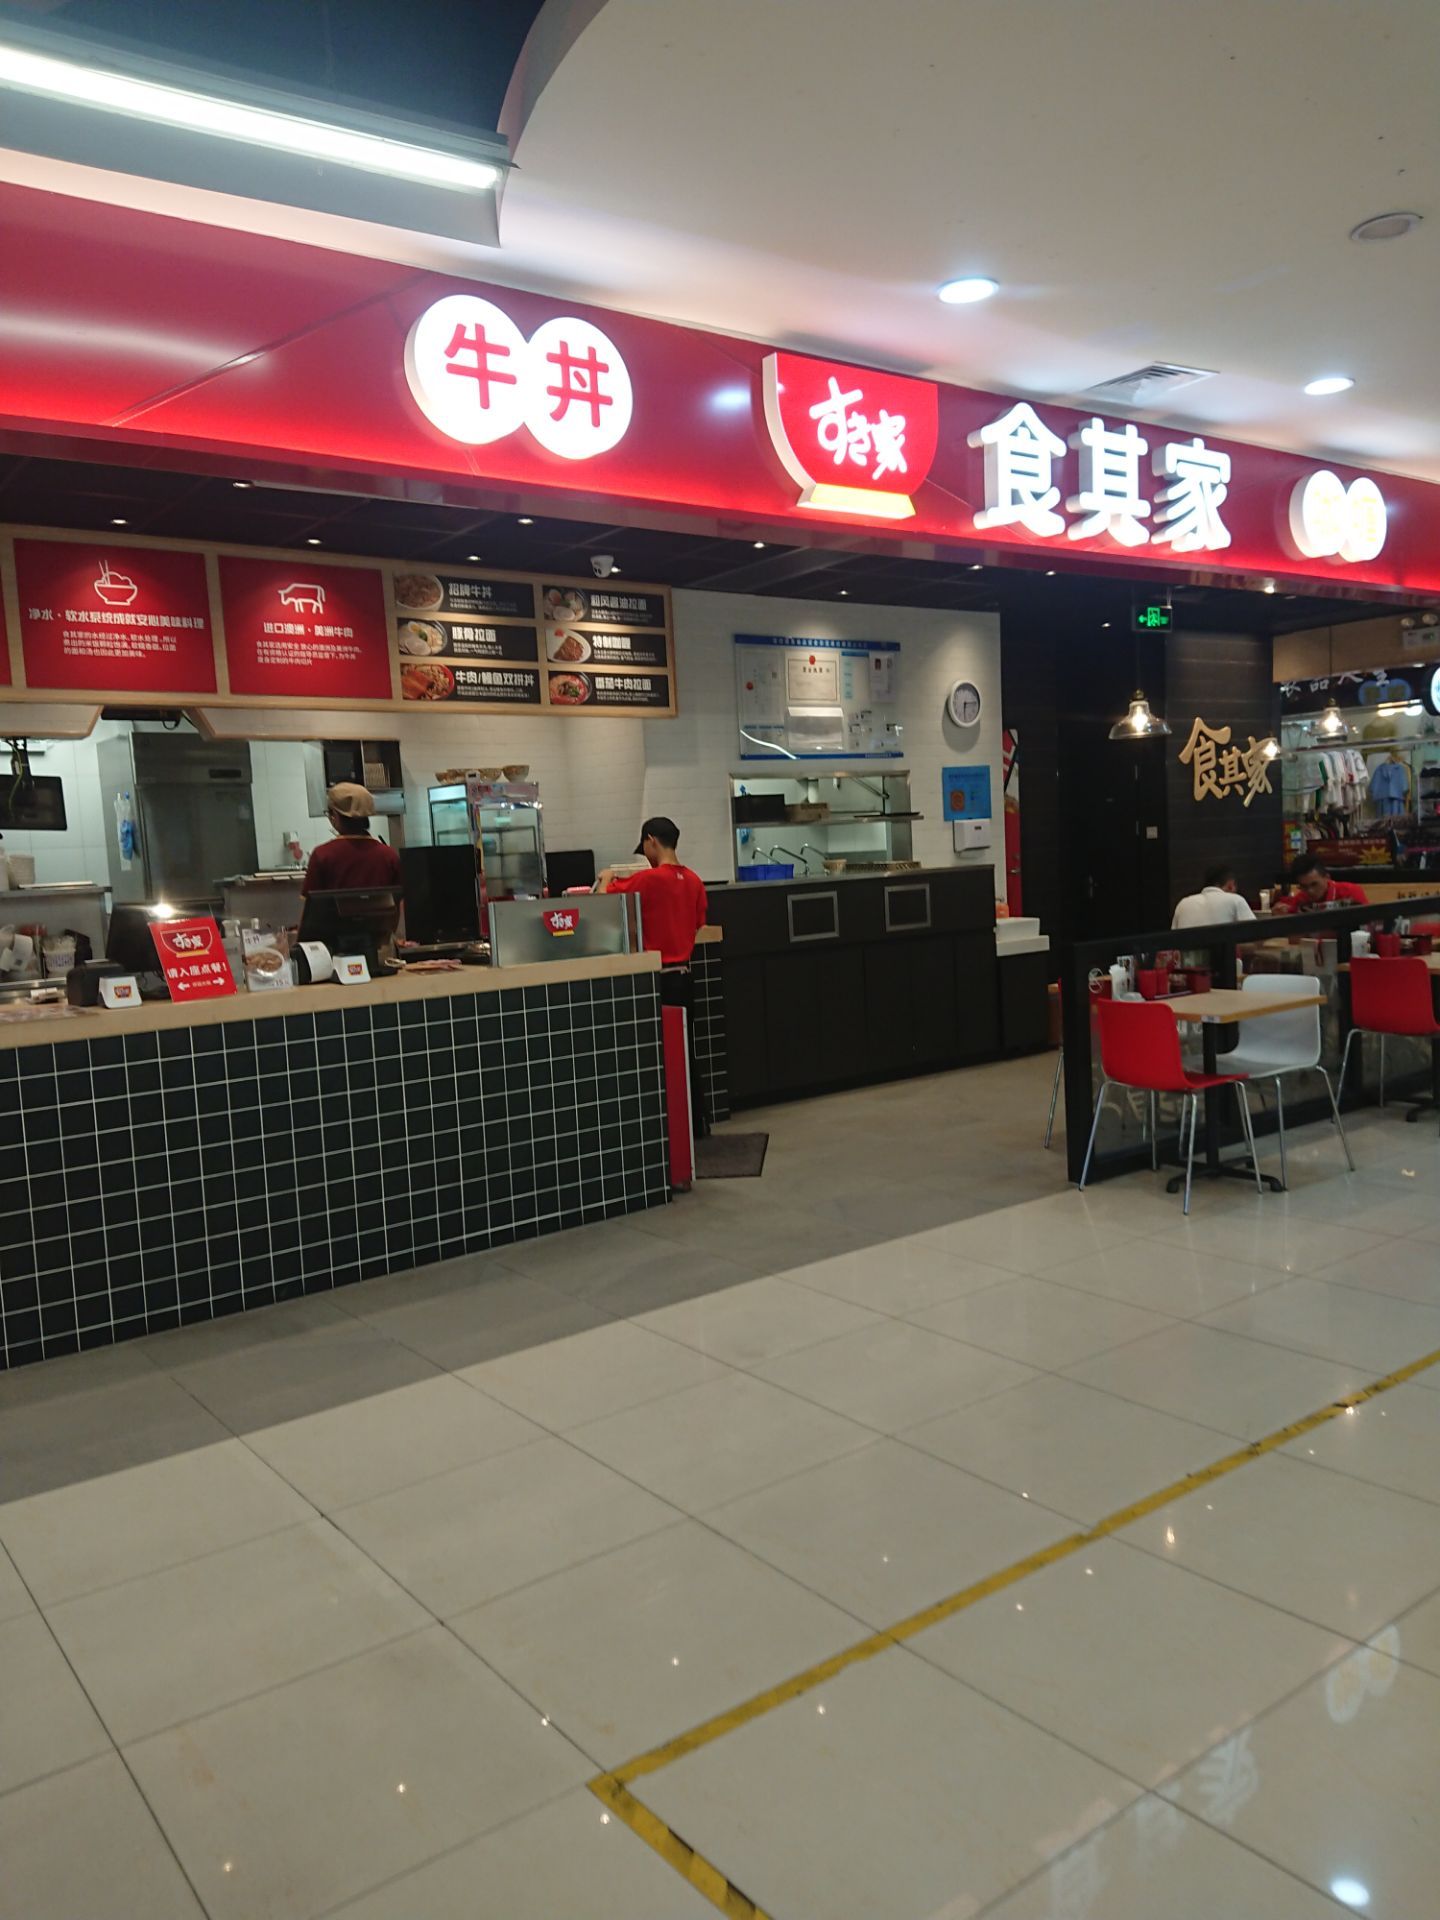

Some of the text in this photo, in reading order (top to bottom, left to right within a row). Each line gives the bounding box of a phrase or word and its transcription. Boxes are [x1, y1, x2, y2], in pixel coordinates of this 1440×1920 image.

[444, 323, 613, 427] 牛丼
[808, 375, 908, 481] すき家
[967, 402, 1231, 552] 食其家
[448, 582, 493, 598] 招牌牛丼
[451, 626, 497, 643] 豚骨拉面
[1179, 716, 1280, 808] 食其家
